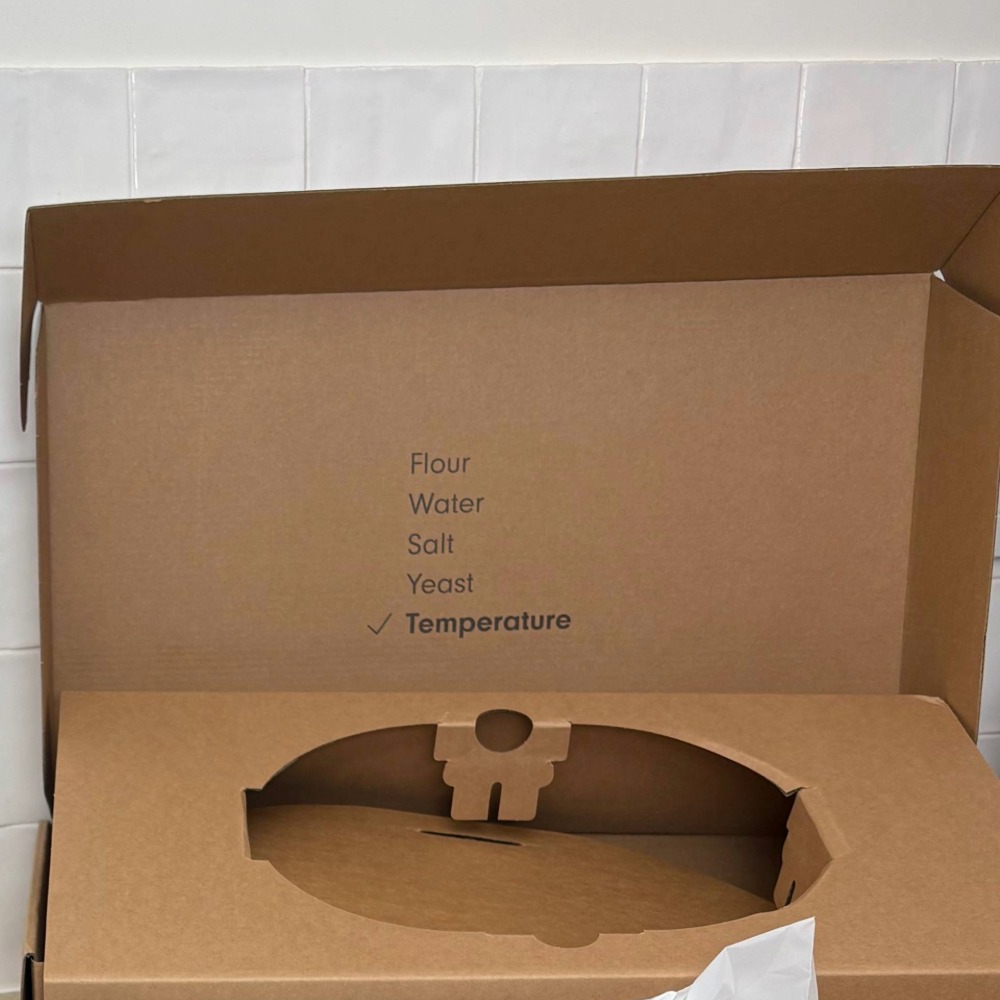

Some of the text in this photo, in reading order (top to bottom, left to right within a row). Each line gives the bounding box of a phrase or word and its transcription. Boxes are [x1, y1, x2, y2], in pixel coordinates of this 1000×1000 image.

[410, 452, 471, 475] Flour
[408, 493, 485, 515] Water
[408, 533, 454, 555] Salt
[406, 573, 474, 594] Yeast
[405, 612, 572, 638] Temperature
